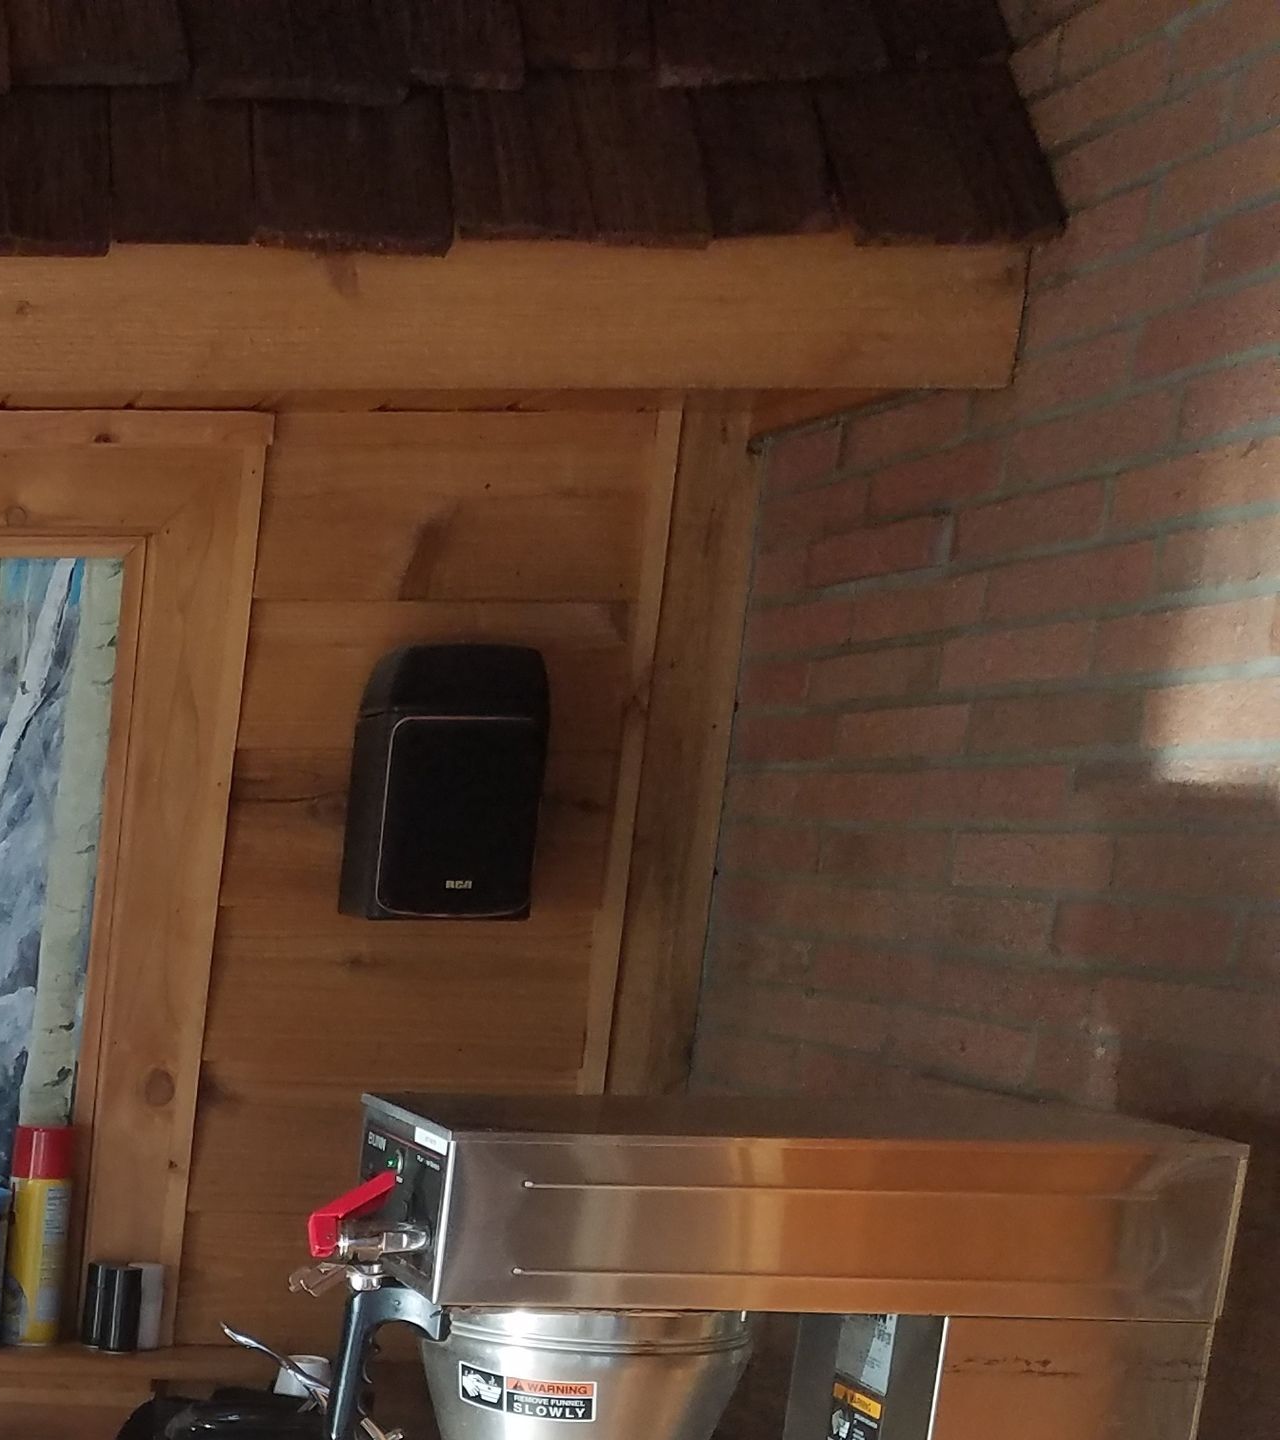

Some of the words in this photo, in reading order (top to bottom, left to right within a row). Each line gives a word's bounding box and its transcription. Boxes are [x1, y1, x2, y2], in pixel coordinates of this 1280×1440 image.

[445, 880, 473, 889] RCA
[527, 1384, 588, 1395] WARNING
[513, 1395, 549, 1406] REMOVE
[550, 1399, 586, 1407] FUNNEL
[512, 1402, 586, 1418] SLOWLY
